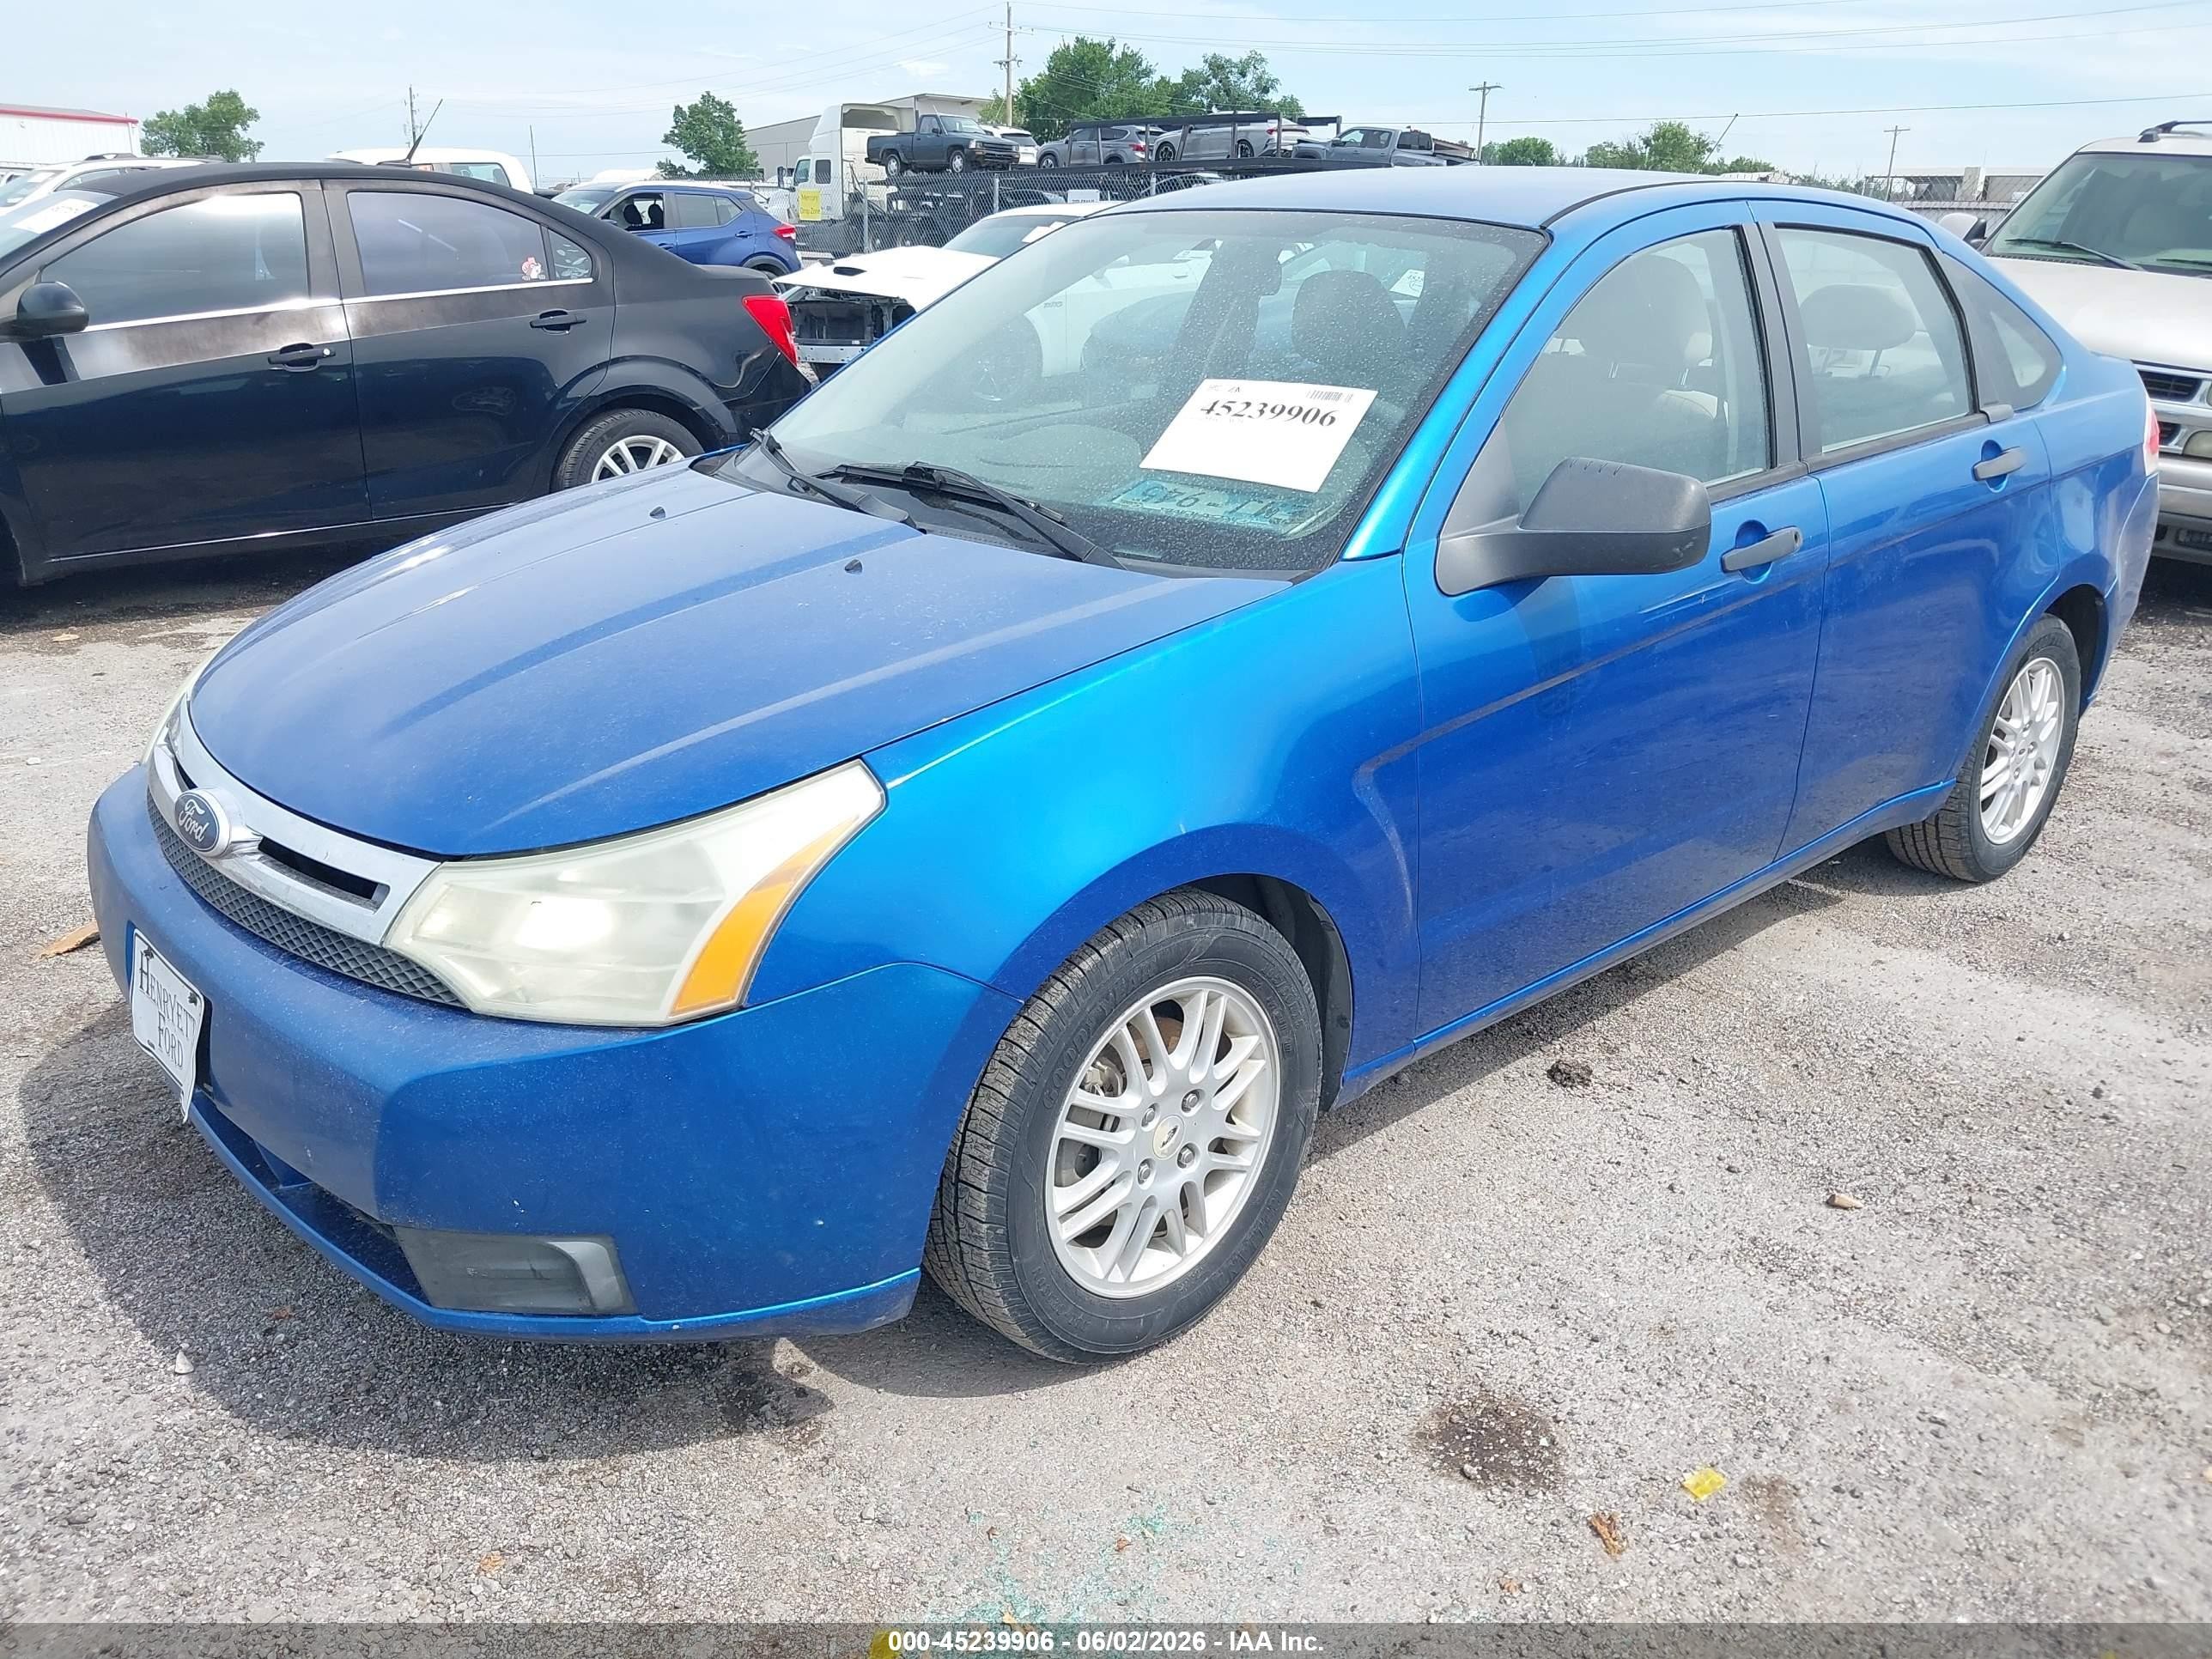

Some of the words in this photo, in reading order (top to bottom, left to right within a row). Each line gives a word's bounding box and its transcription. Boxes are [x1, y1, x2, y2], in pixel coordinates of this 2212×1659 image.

[1200, 399, 1340, 426] 45239906
[179, 799, 210, 842] Ford
[158, 1009, 183, 1068] FORD
